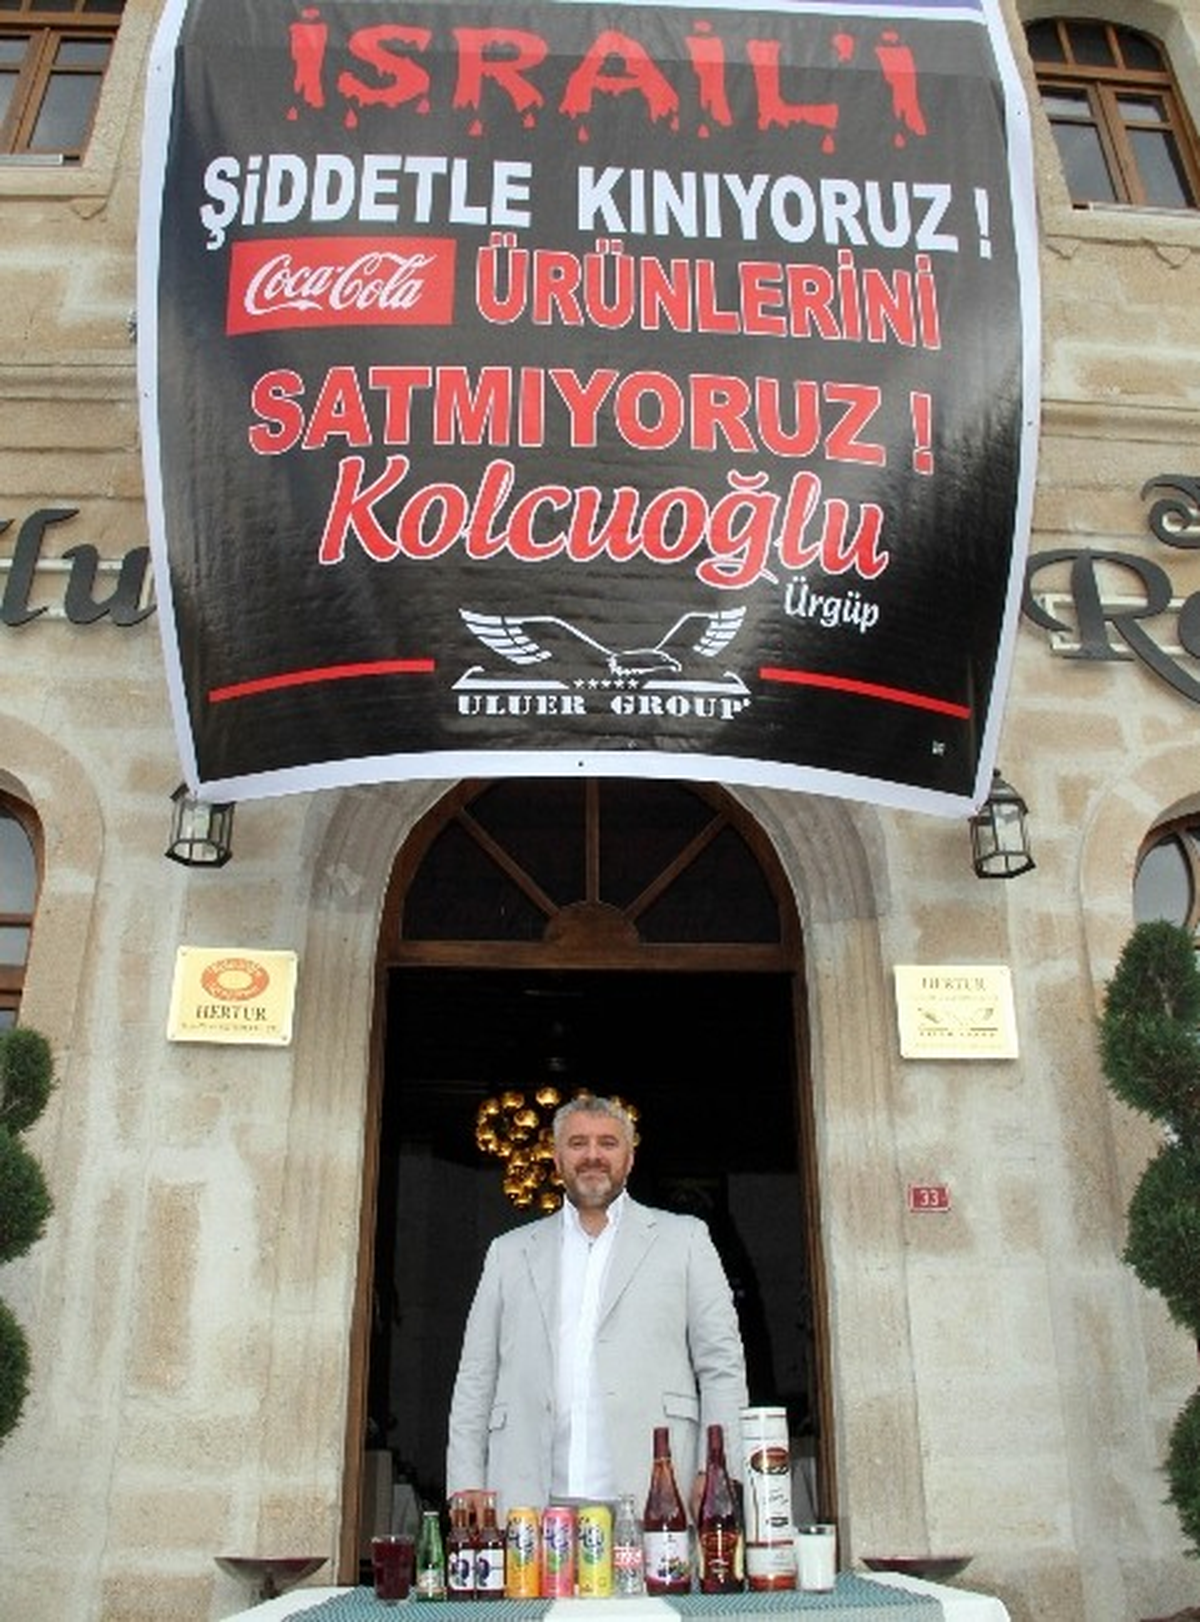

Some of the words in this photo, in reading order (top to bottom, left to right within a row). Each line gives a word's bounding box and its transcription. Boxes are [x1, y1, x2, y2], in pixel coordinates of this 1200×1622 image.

[578, 166, 959, 253] KINIYORUZ
[974, 188, 992, 260] !
[476, 232, 941, 350] ÜRÜNLERİNİ
[249, 367, 886, 468] SATMIYORUZ
[911, 391, 934, 475] !
[0, 508, 157, 627] lu
[318, 455, 889, 589] Kolcuoğlu
[785, 576, 879, 634] Ürgüp
[458, 695, 587, 716] ULUER
[919, 1189, 939, 1206] 33
